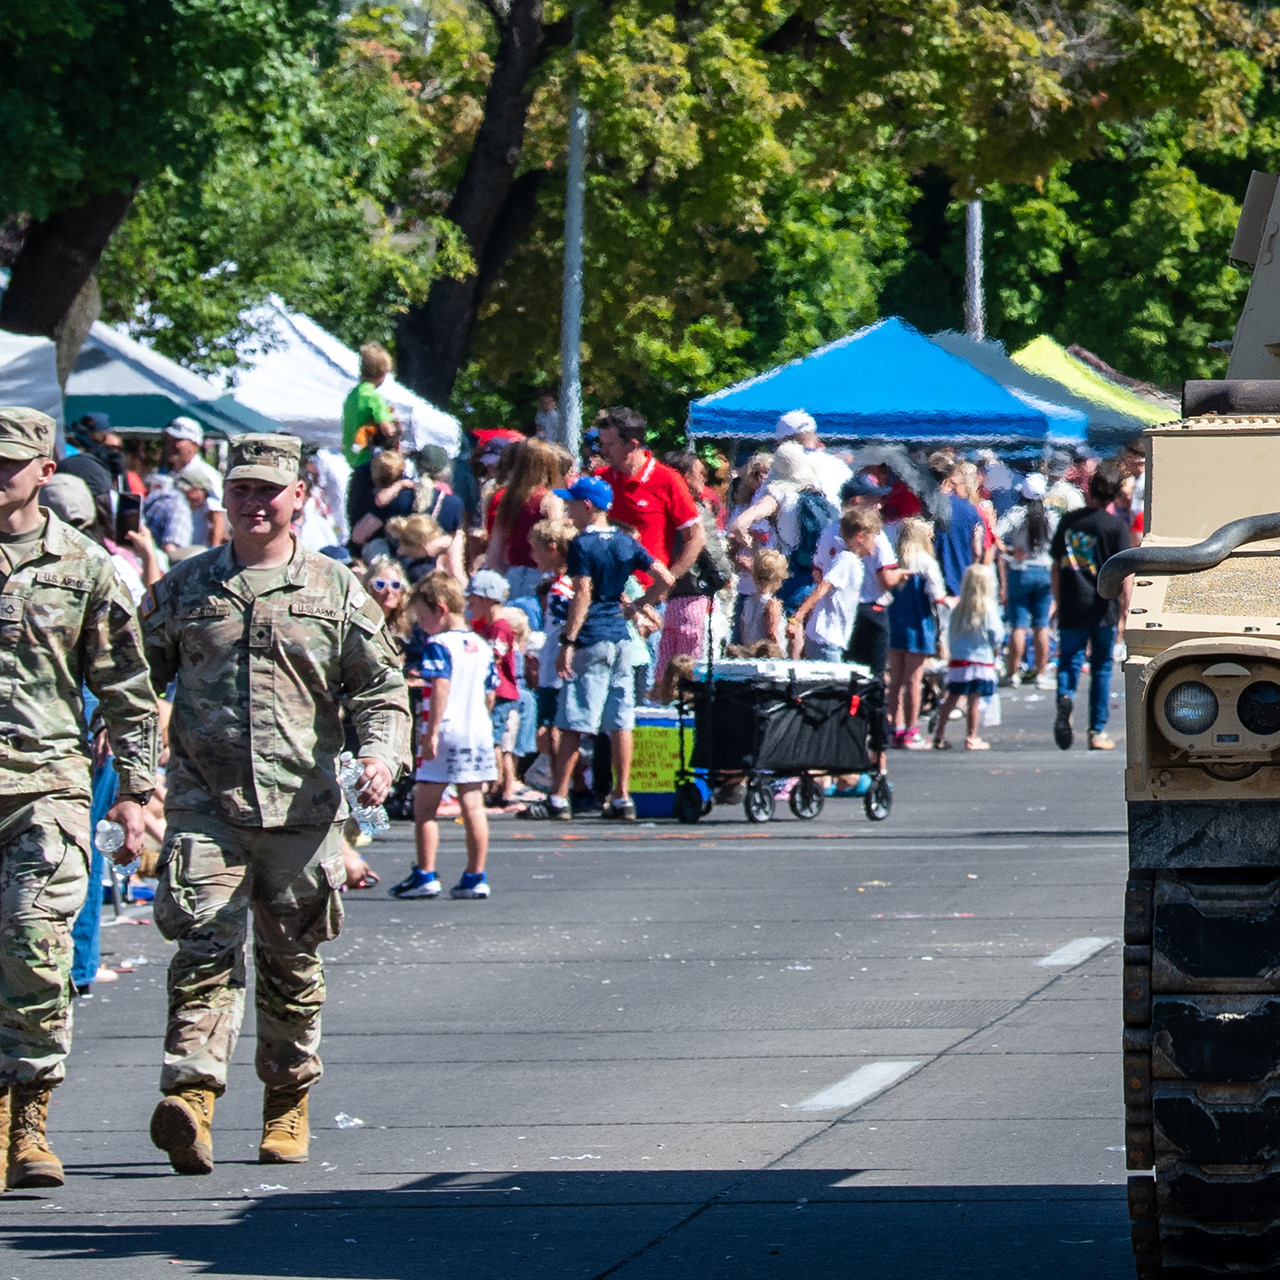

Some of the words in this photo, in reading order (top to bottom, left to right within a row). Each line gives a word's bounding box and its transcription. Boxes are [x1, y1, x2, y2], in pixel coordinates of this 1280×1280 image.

[44, 574, 58, 584] U.S.
[61, 577, 84, 587] ARMY
[315, 607, 338, 618] ARMY
